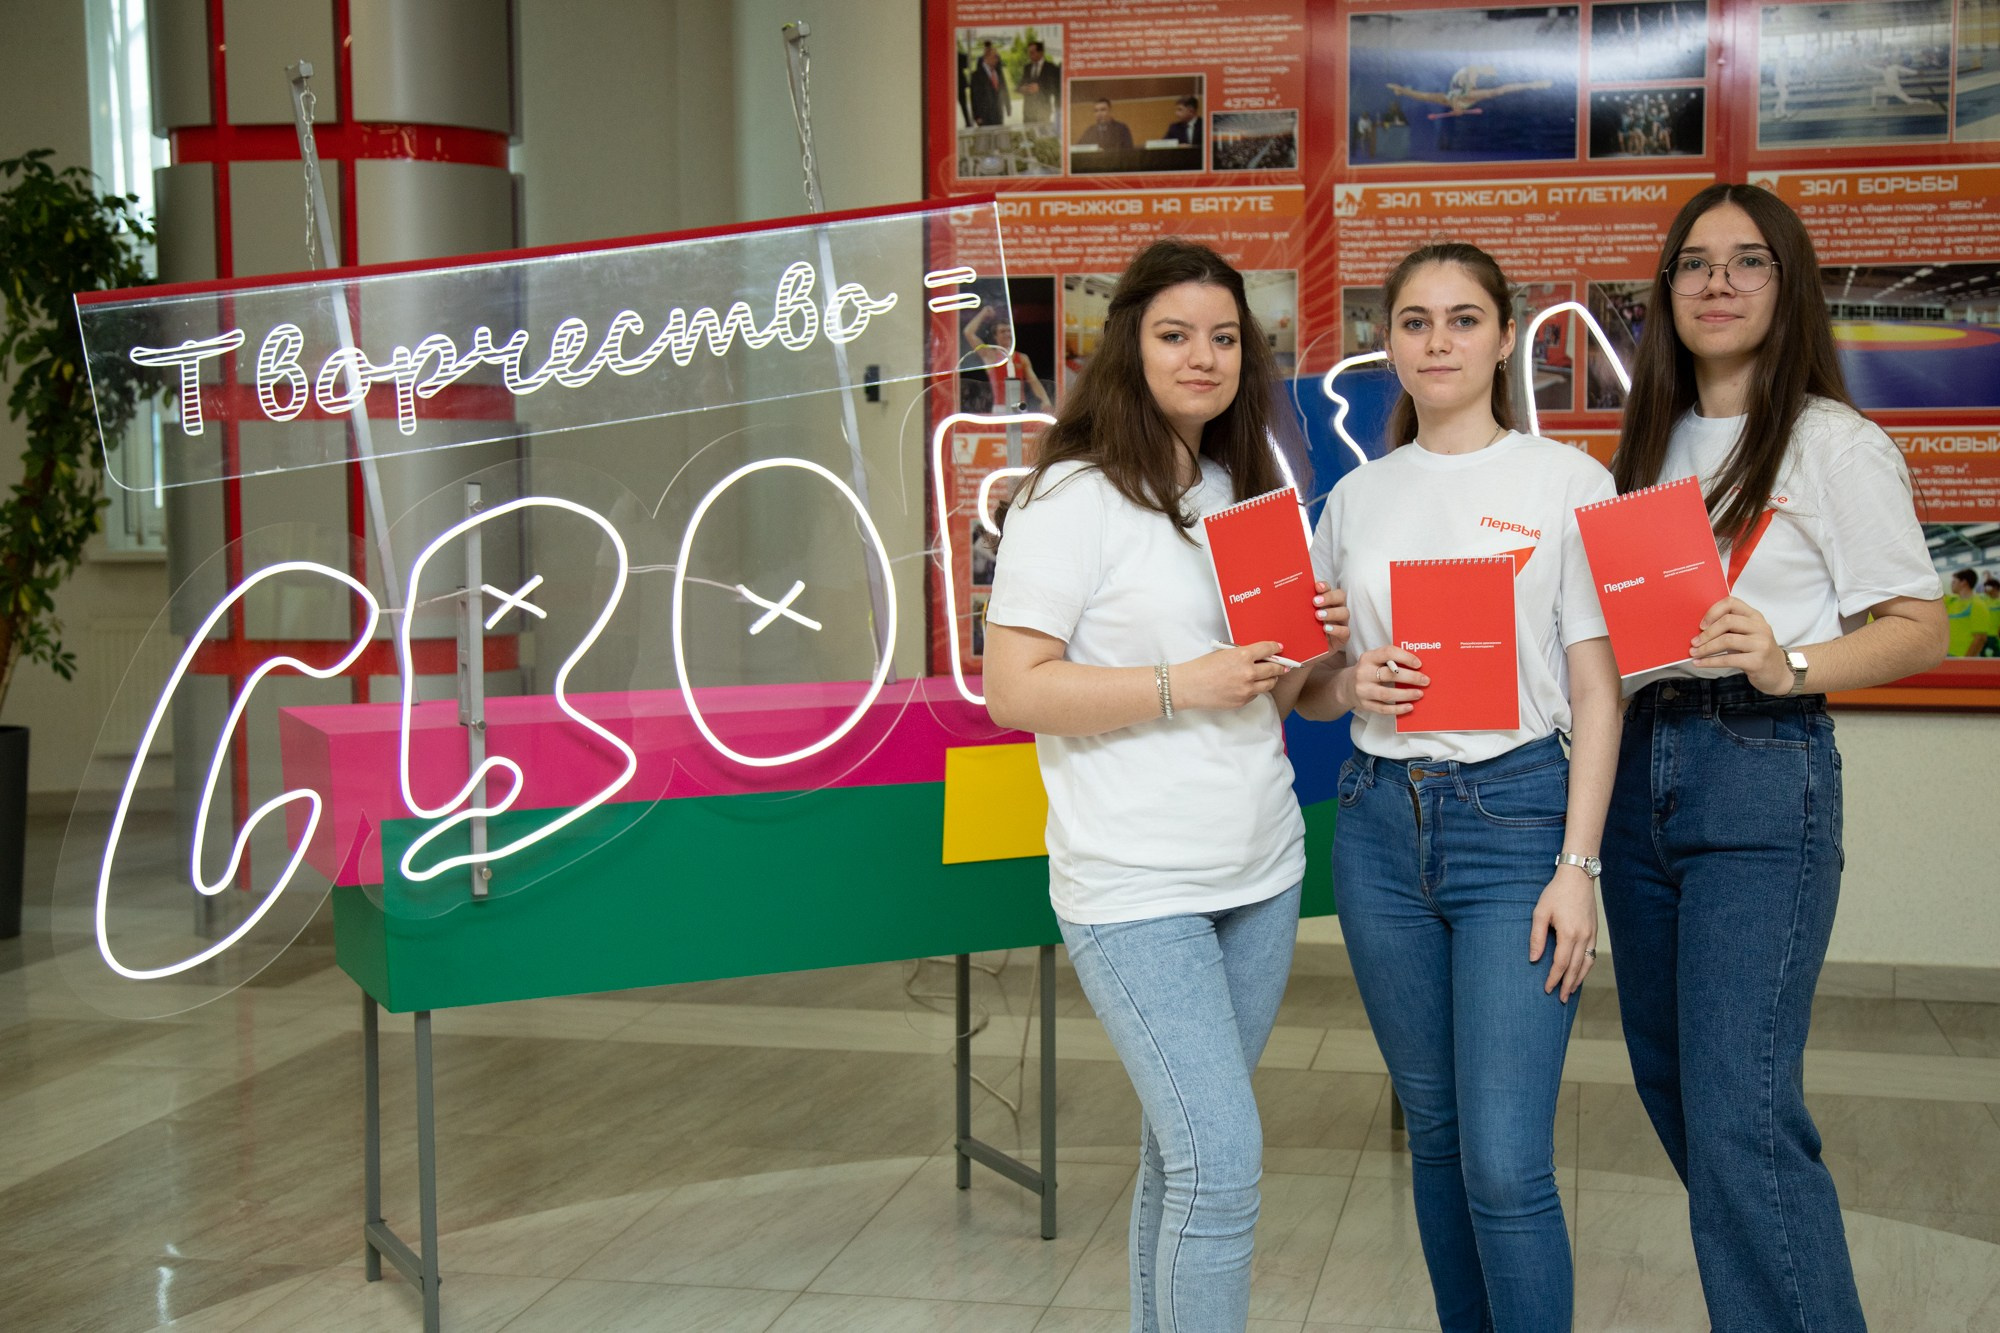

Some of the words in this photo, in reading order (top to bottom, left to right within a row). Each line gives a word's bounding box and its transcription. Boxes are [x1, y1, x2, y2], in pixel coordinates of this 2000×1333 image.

[1800, 178, 1848, 197] ЗАЛ
[1857, 175, 1959, 195] БОРЬБЫ
[1039, 197, 1144, 216] ПРЫЖКОВ
[1152, 197, 1182, 214] НА
[1190, 195, 1275, 213] БАТУТЕ
[1375, 191, 1422, 210] ЗАЛ
[1431, 185, 1538, 208] ТЯЖЕЛОЙ
[1546, 184, 1668, 206] АТЛЕТИКИ
[130, 260, 897, 437] Творчество
[1480, 516, 1542, 540] Первые
[1228, 586, 1262, 605] Первые
[1603, 576, 1646, 594] Первые
[1400, 641, 1442, 653] Первые
